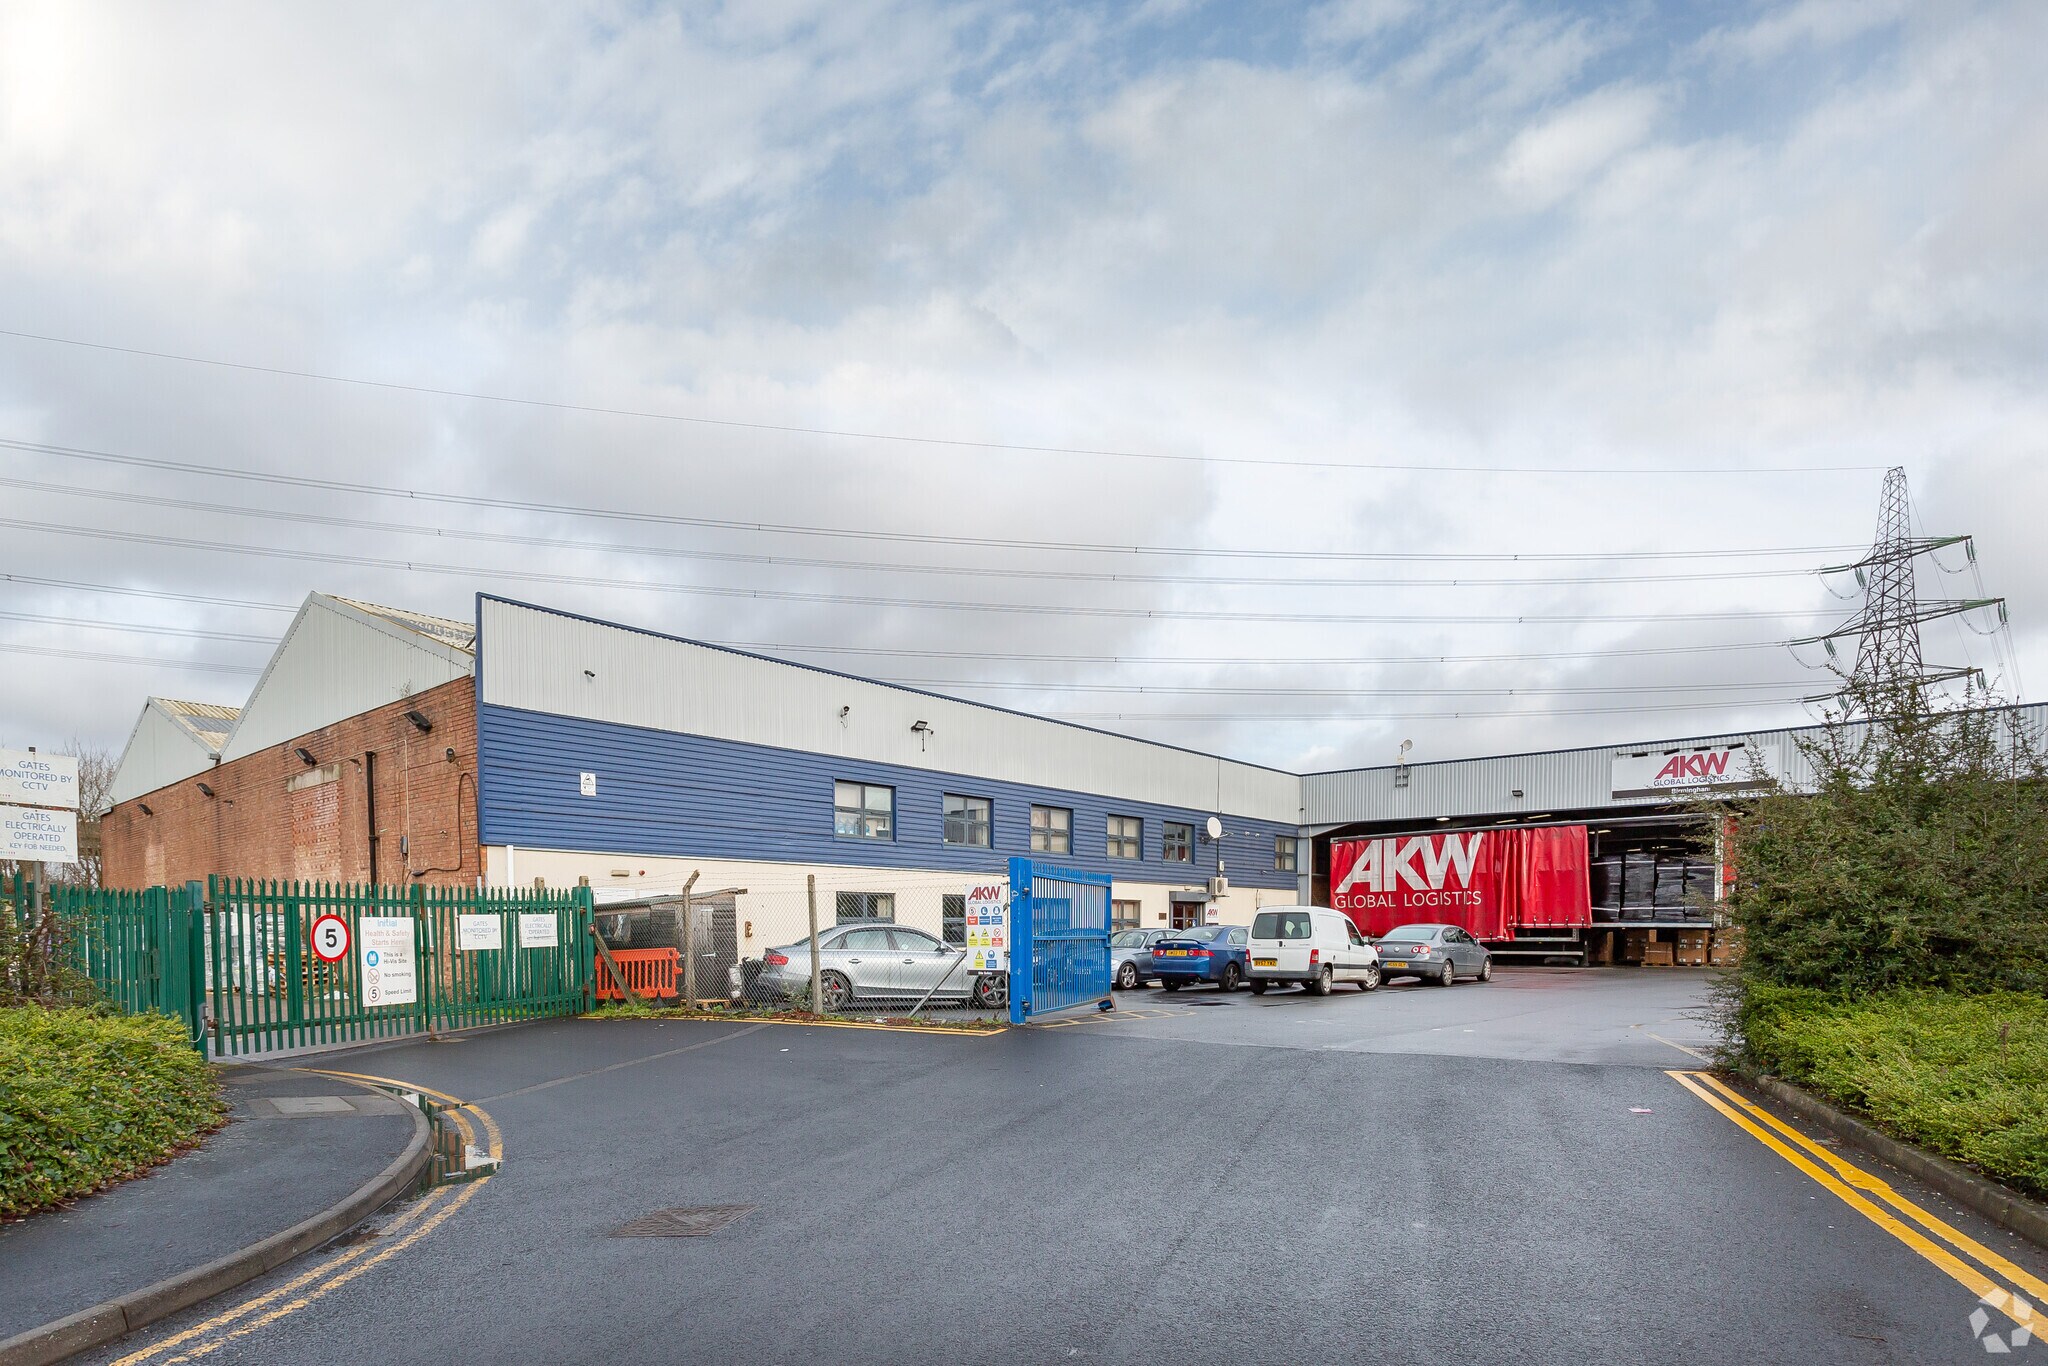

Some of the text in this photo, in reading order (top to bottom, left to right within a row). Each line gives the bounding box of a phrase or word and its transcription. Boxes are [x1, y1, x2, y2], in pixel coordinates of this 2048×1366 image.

[19, 761, 50, 771] GATES
[1655, 752, 1730, 779] AKW
[22, 781, 48, 790] CCTV
[1653, 775, 1730, 787] GLOBAL LOGISTICS
[23, 812, 51, 821] GATES
[5, 821, 67, 832] ELECTRICALLY
[14, 832, 60, 842] OPERATED
[1335, 832, 1483, 893] AKW
[968, 886, 1001, 900] AKW
[1335, 891, 1482, 909] GLOBAL LOGISTICS
[1207, 908, 1218, 916] AKW
[325, 929, 337, 948] 5
[392, 930, 410, 938] Safety
[371, 989, 377, 999] 5
